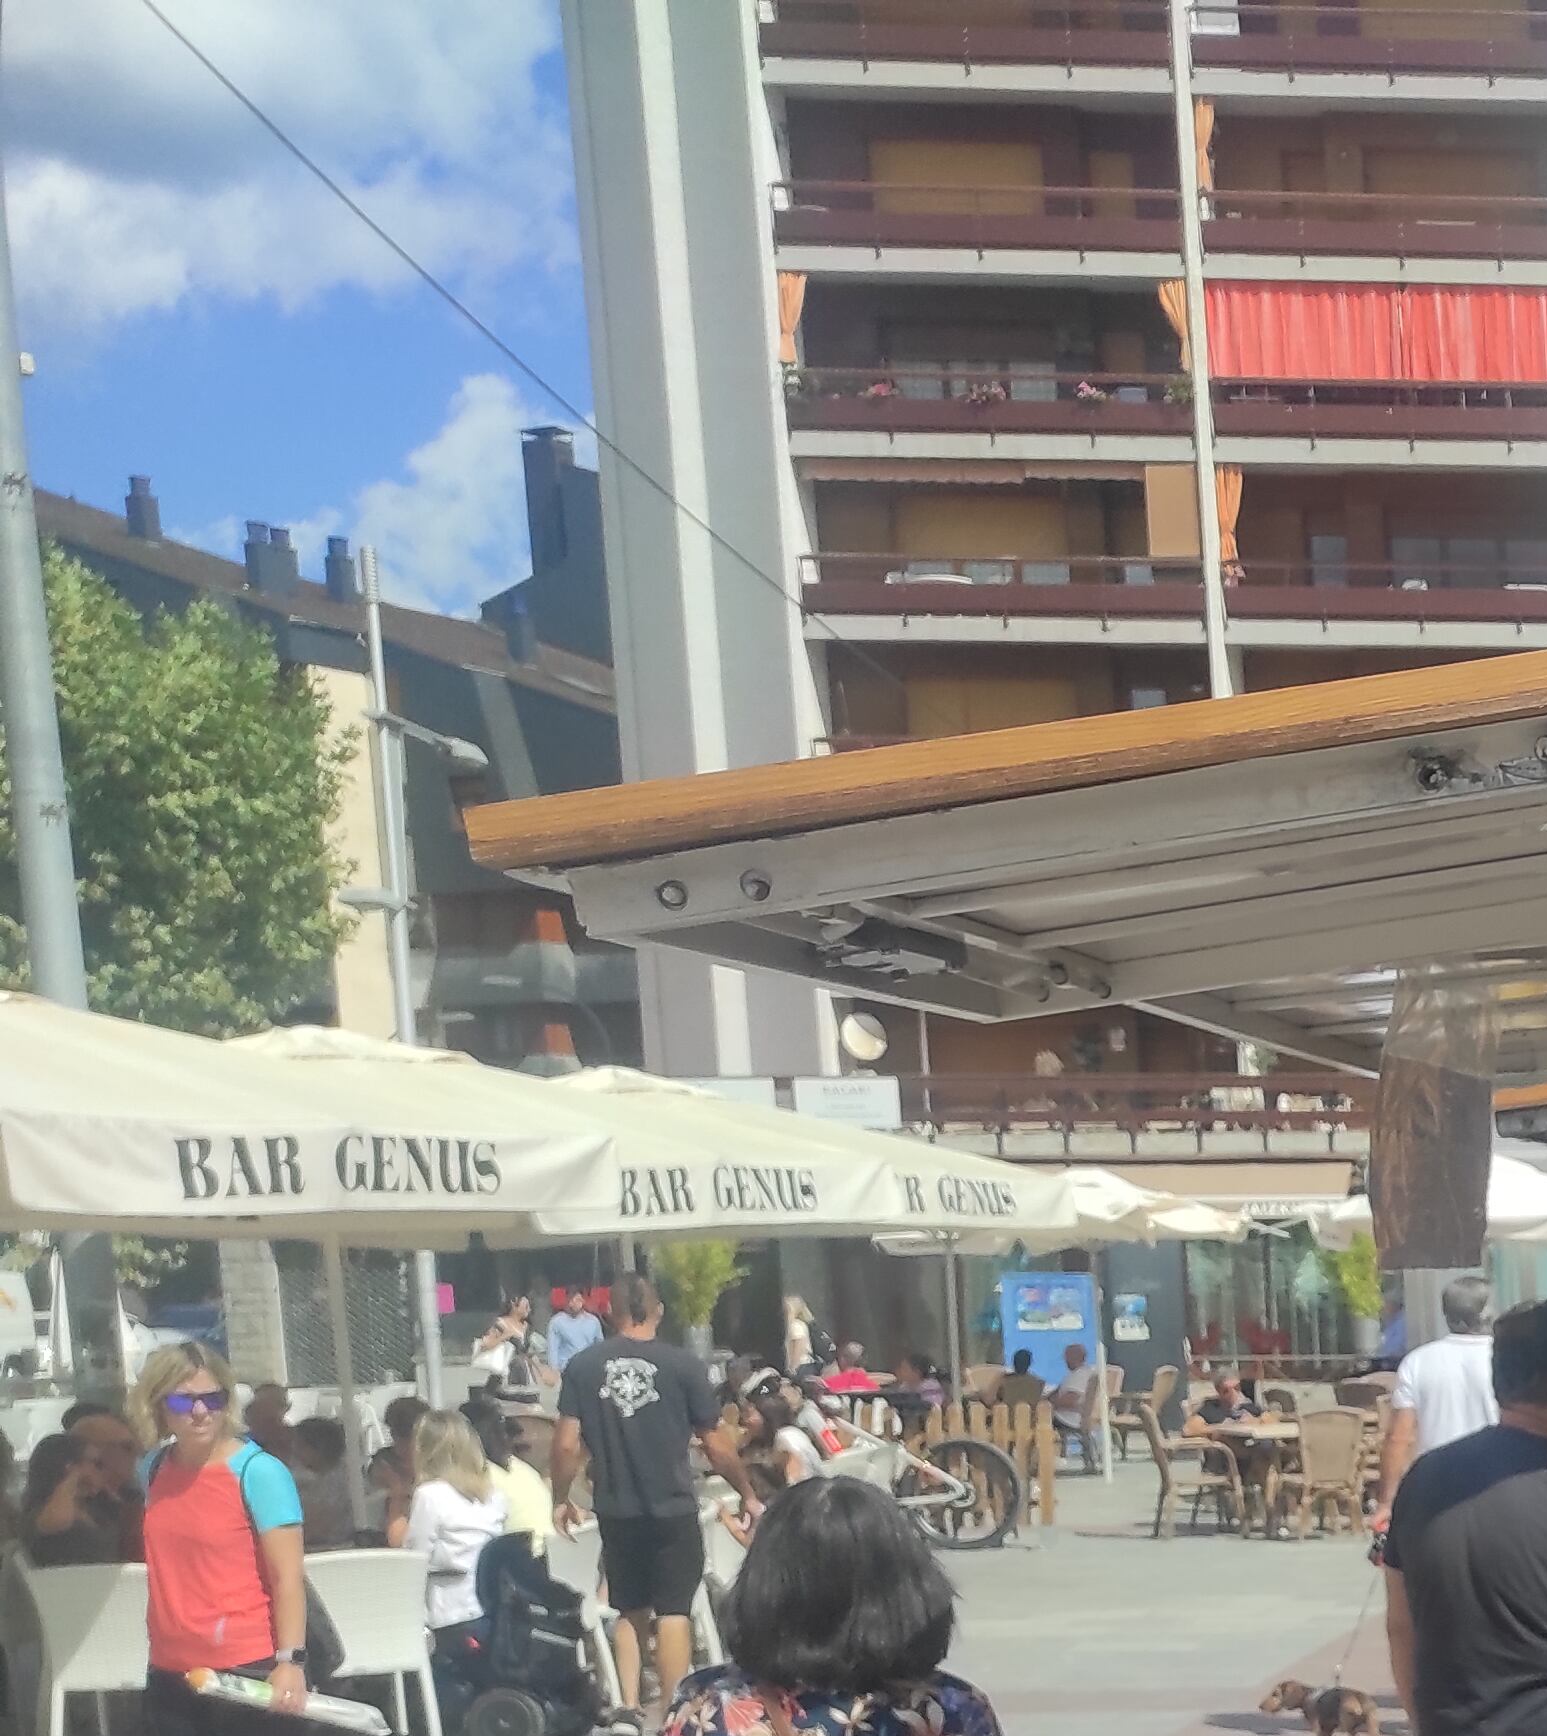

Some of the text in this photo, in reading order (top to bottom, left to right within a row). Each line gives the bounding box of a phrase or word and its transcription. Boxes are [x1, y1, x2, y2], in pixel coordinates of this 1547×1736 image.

[174, 1135, 504, 1200] BAR GENUS
[620, 1165, 818, 1217] BAR GENUS
[937, 1175, 1018, 1216] GENUS
